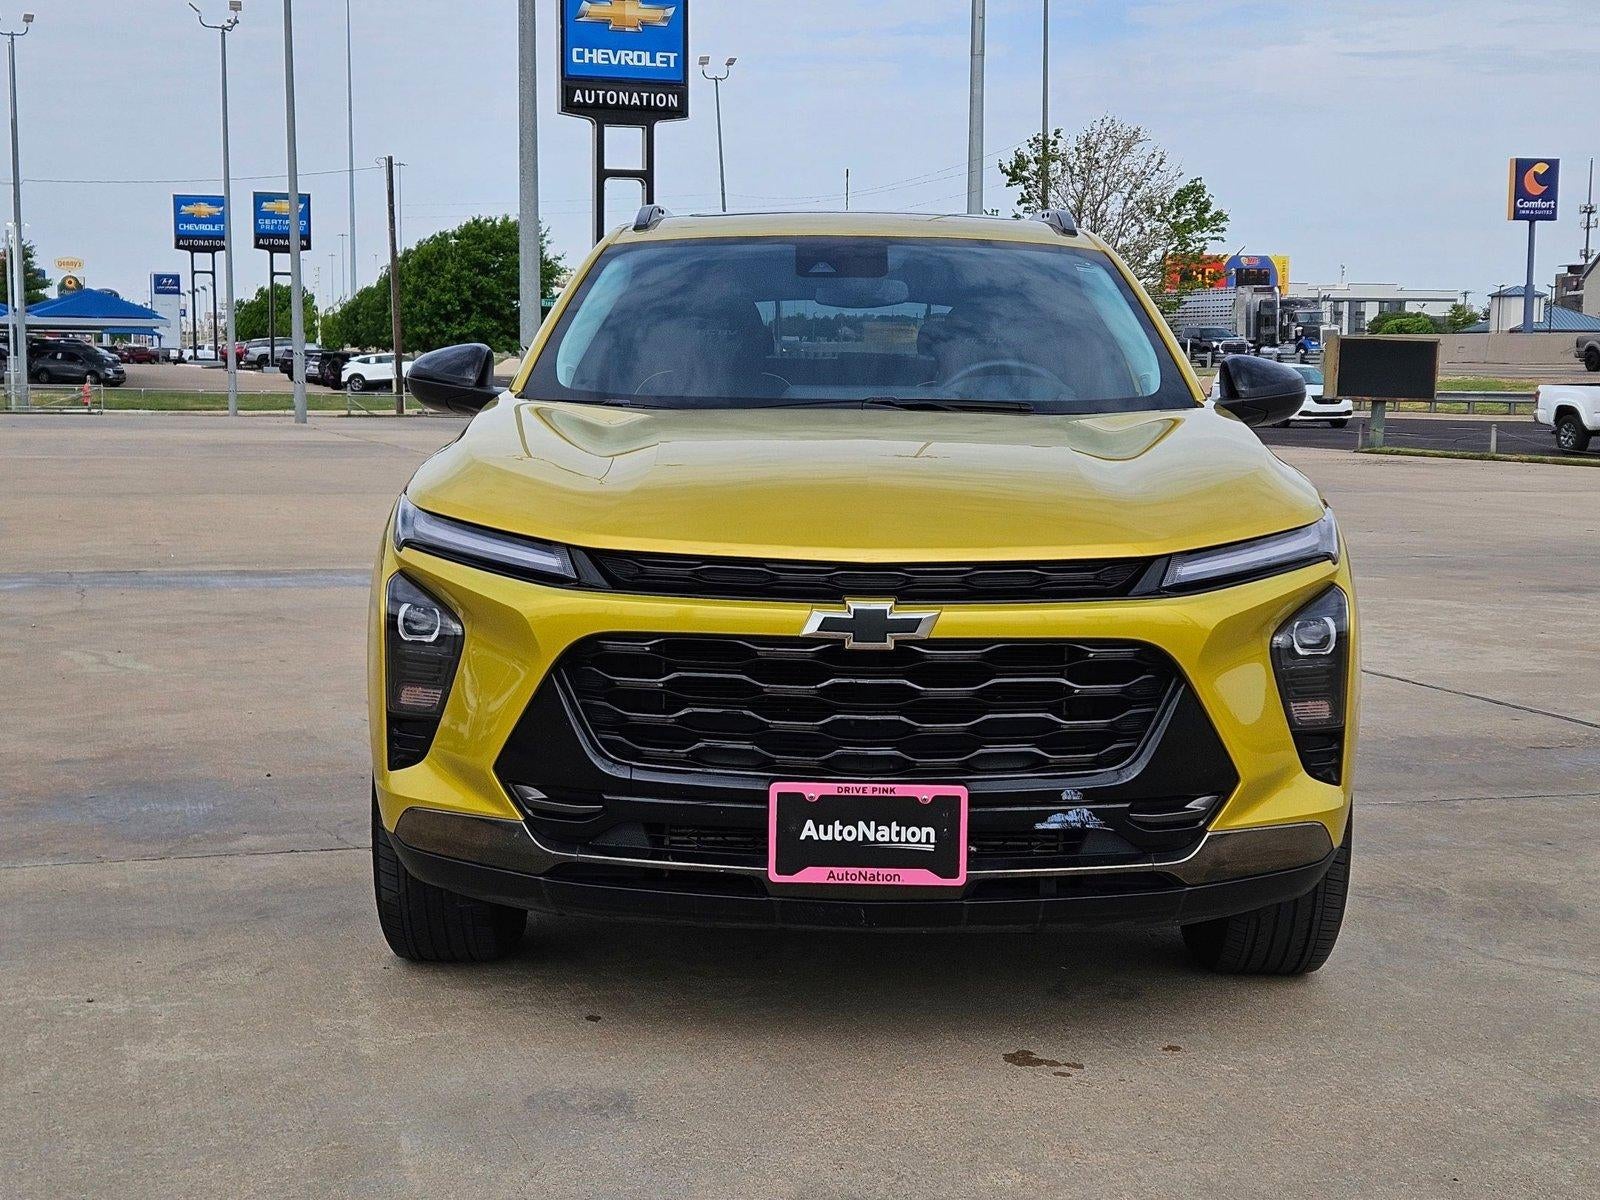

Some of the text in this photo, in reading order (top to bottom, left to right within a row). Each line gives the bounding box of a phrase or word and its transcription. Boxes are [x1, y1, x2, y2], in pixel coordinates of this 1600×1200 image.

[572, 47, 678, 68] CHEVROLET
[573, 89, 678, 108] AUTONATION
[1517, 198, 1556, 209] Comfort
[178, 223, 225, 231] CHEVROLET
[258, 218, 307, 226] CERTIFD
[178, 239, 226, 247] AUTONATION
[258, 238, 307, 247] AUTONAN
[836, 785, 897, 795] DRIVE PINK
[799, 819, 936, 843] AutoNation
[826, 869, 901, 883] AutoNation
